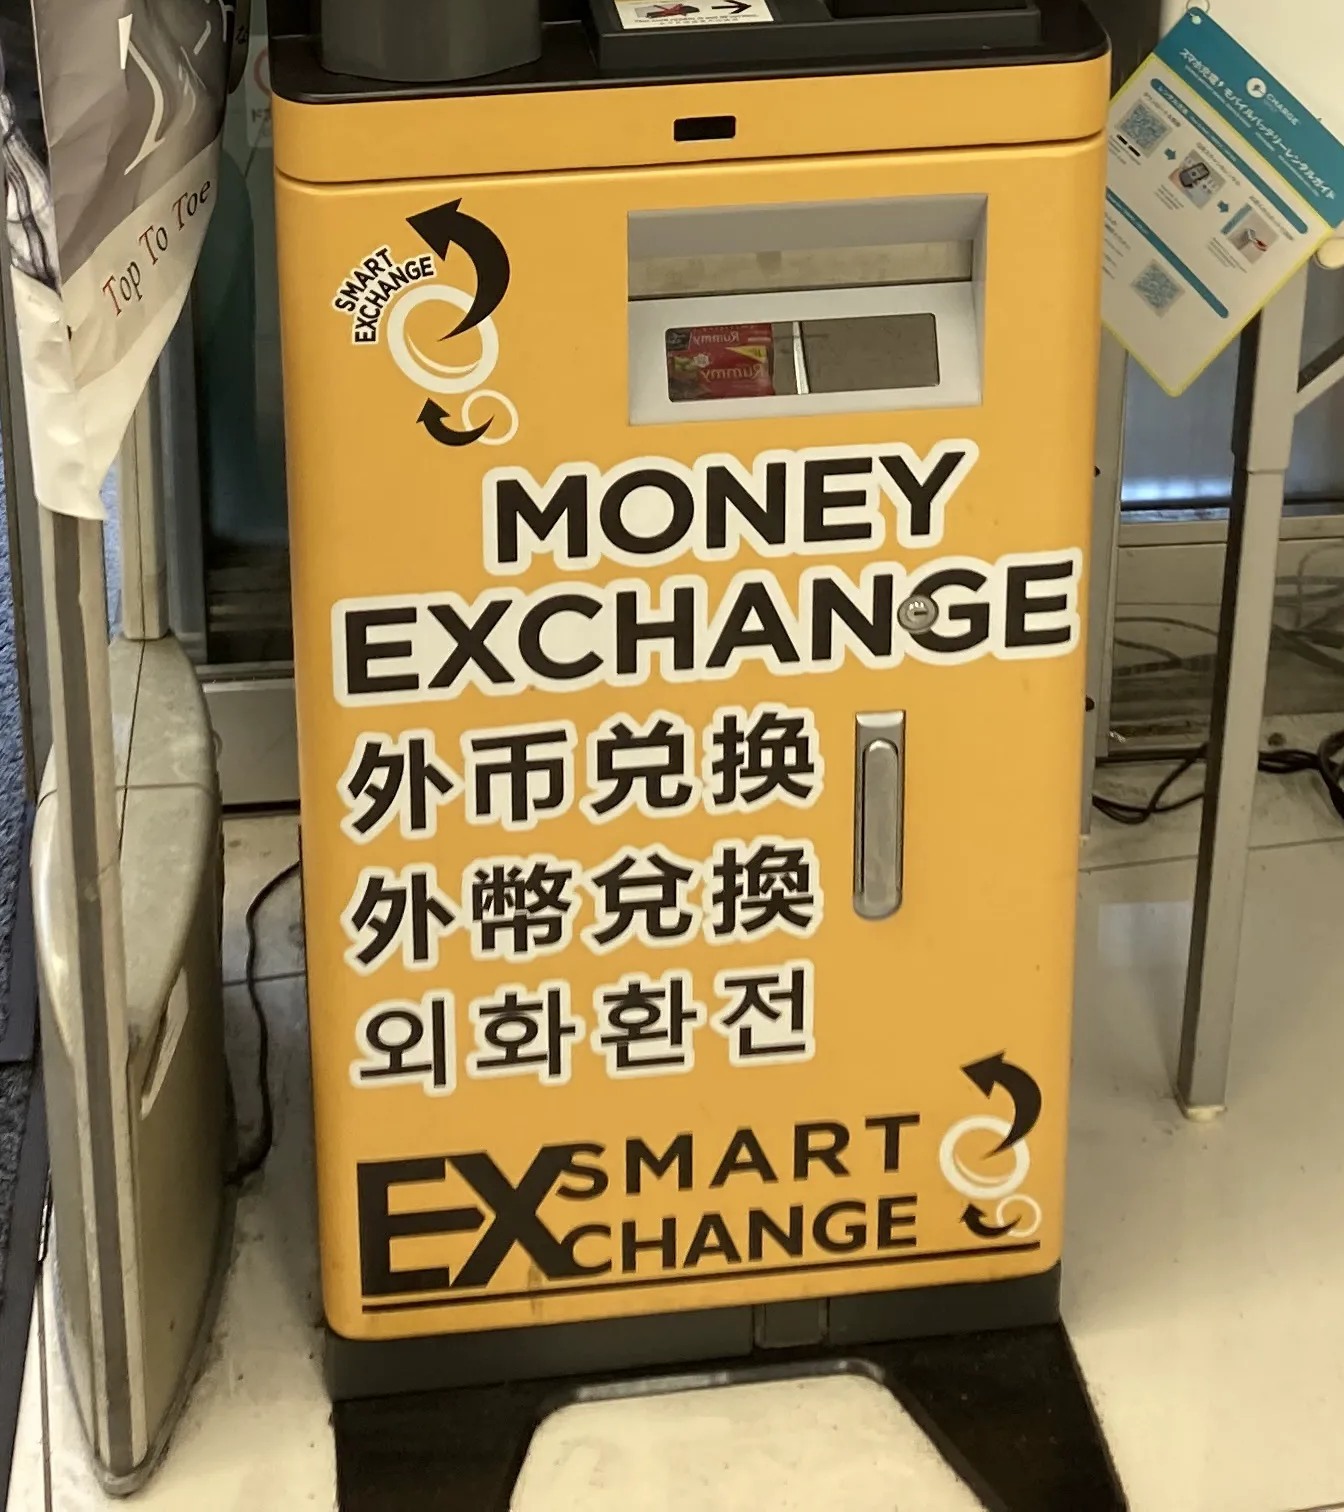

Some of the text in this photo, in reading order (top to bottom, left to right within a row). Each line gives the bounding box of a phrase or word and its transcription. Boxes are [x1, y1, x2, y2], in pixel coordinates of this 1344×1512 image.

[102, 179, 211, 317] Top To Toe
[335, 248, 392, 311] SMART
[355, 256, 434, 342] EXCHANGE
[497, 451, 966, 563] MONEY
[345, 559, 1073, 694] EXCHANGE
[348, 713, 816, 834] 外币兑换
[350, 845, 814, 967] 外幣兌換
[358, 968, 808, 1087] 외화환전
[356, 1114, 921, 1297] EX SMART
[558, 1194, 918, 1276] CHANGE
